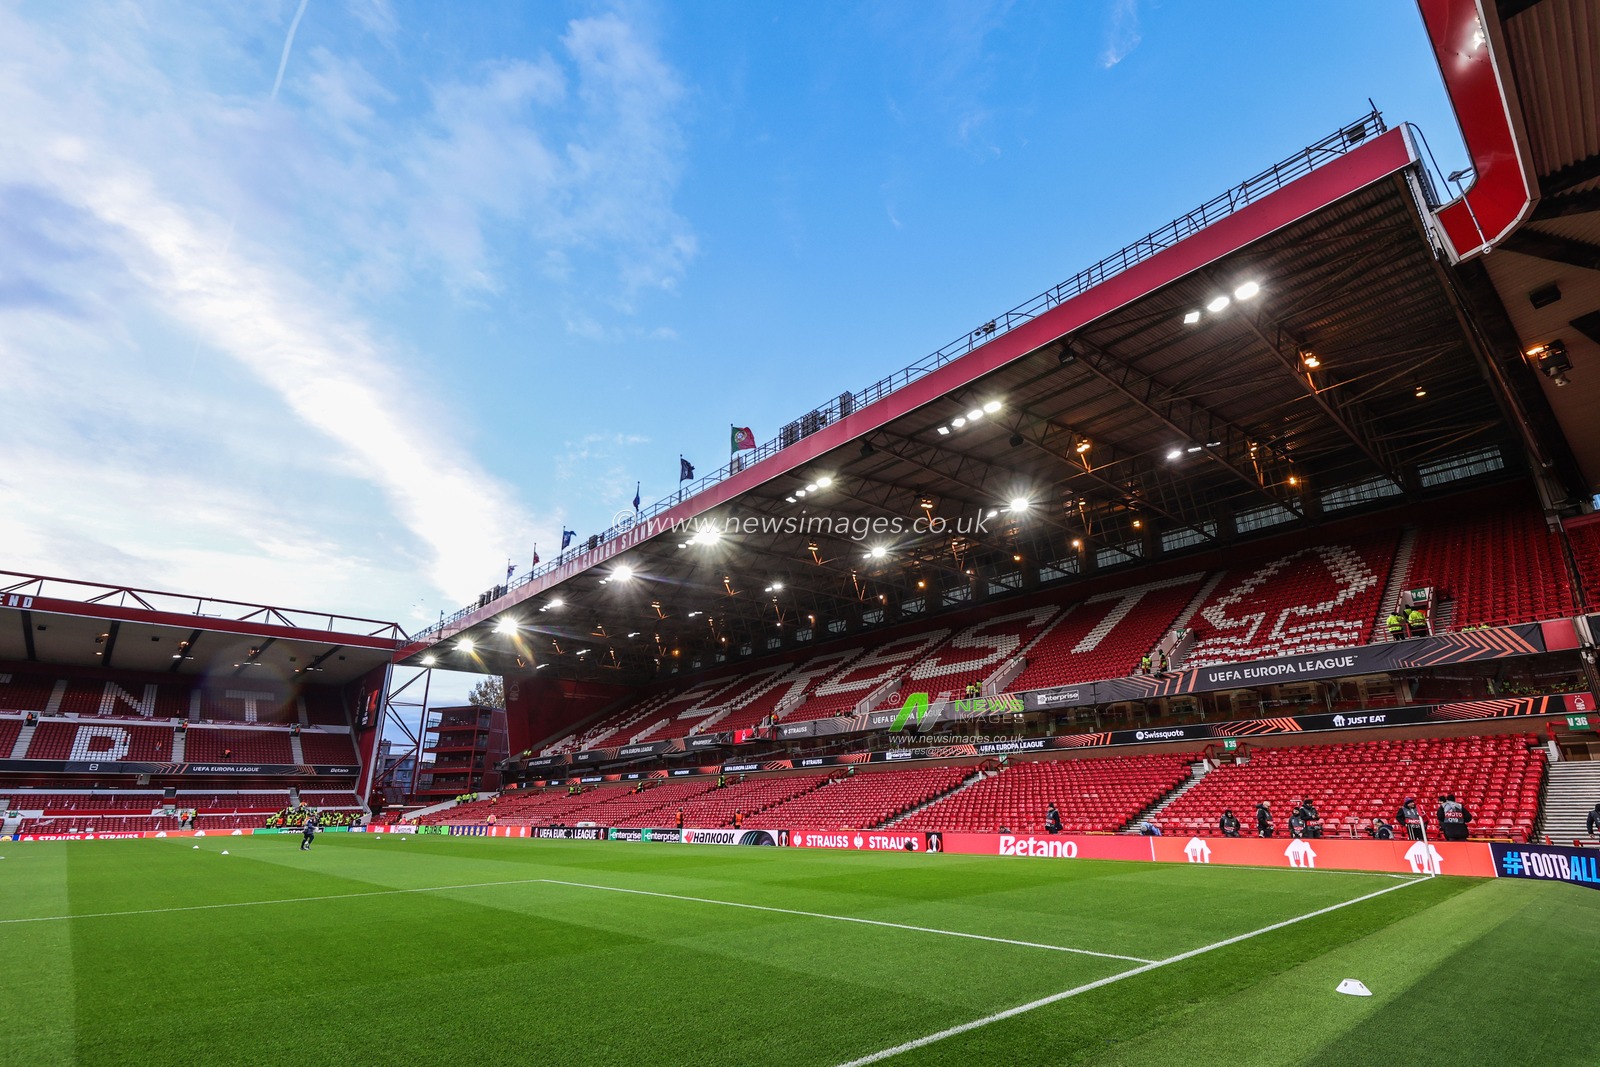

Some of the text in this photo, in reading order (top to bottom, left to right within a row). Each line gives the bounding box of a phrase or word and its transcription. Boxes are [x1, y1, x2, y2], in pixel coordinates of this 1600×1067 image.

[583, 540, 617, 568] CLOUGH
[621, 521, 653, 549] STAND
[1208, 671, 1242, 682] UEFA
[1244, 663, 1296, 679] EUROPA
[873, 716, 889, 724] UEFA
[1347, 715, 1386, 725] JUST EAT
[1567, 717, 1588, 726] V 36
[1144, 729, 1184, 739] Swissquote
[996, 742, 1019, 750] EUROPA
[1229, 740, 1236, 748] 35
[540, 829, 552, 838] UEFA
[611, 831, 641, 841] enterprise
[645, 832, 680, 842] enterprise
[806, 835, 849, 848] STRAUSS
[1000, 836, 1078, 858] Betano
